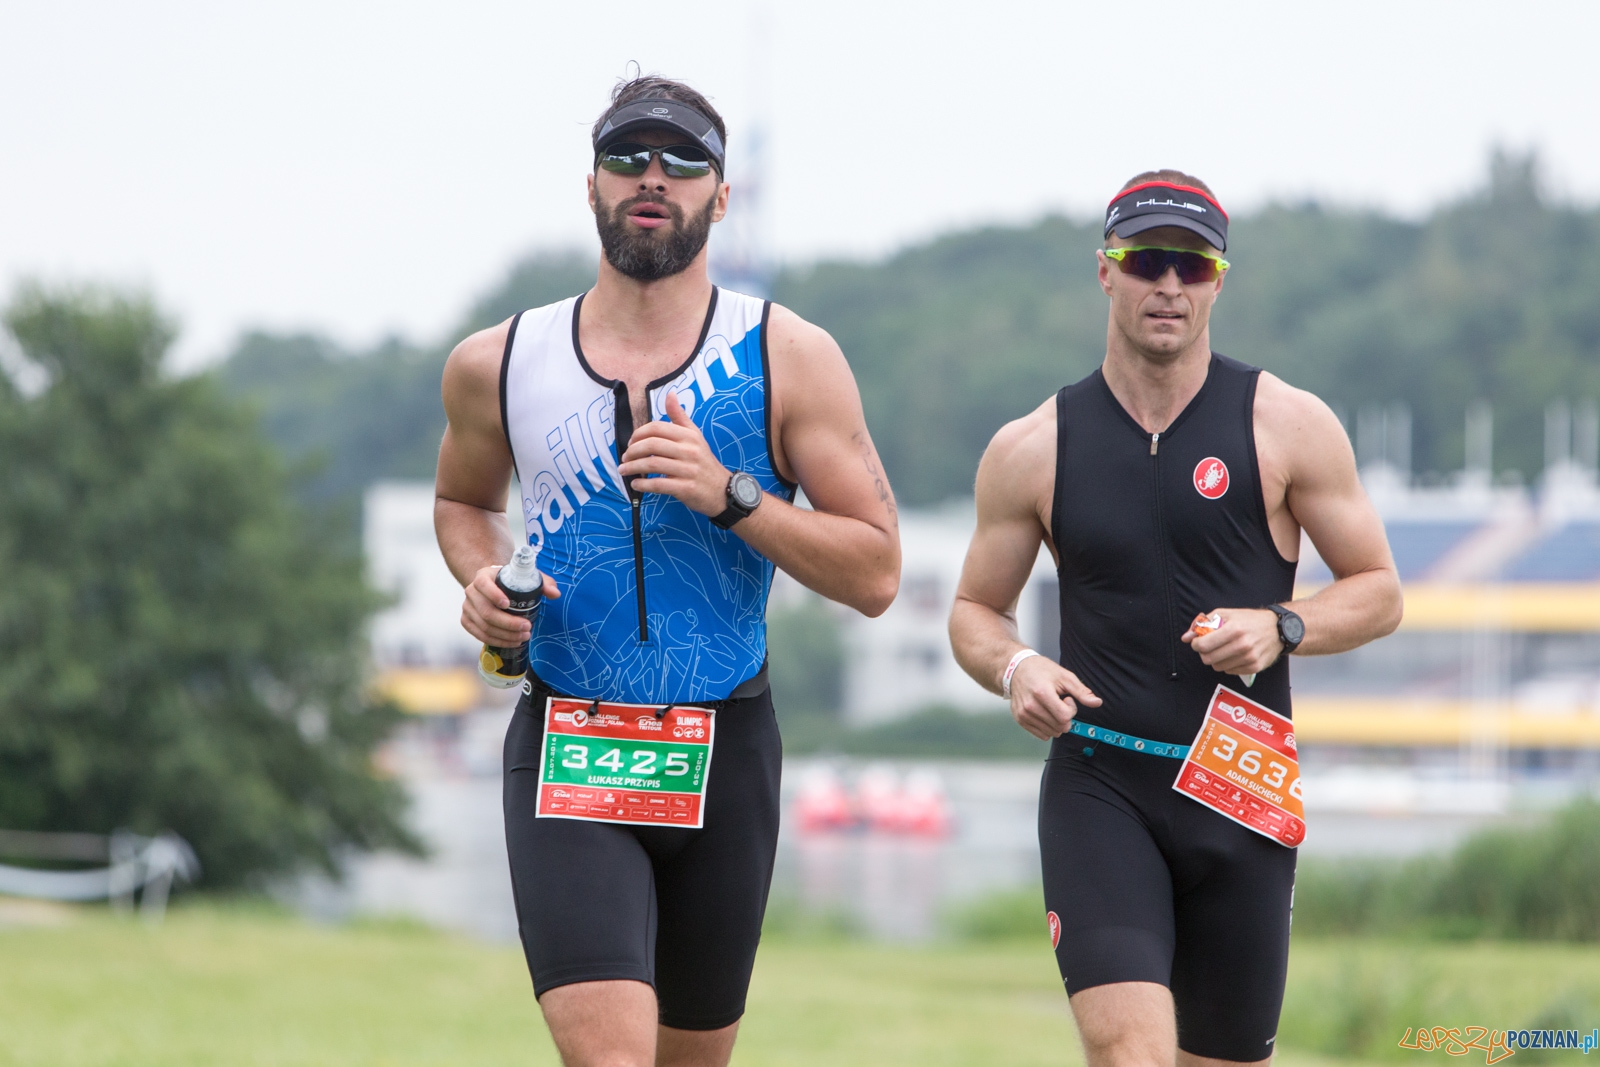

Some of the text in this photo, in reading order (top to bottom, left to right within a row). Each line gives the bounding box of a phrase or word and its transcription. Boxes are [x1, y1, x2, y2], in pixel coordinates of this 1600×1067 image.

[676, 716, 702, 726] OLIMPIC
[562, 744, 690, 776] 3425
[587, 775, 660, 788] ŁUKASZ PRZYPIS
[1226, 769, 1248, 786] ADAM
[1248, 780, 1284, 804] SUCHECKI
